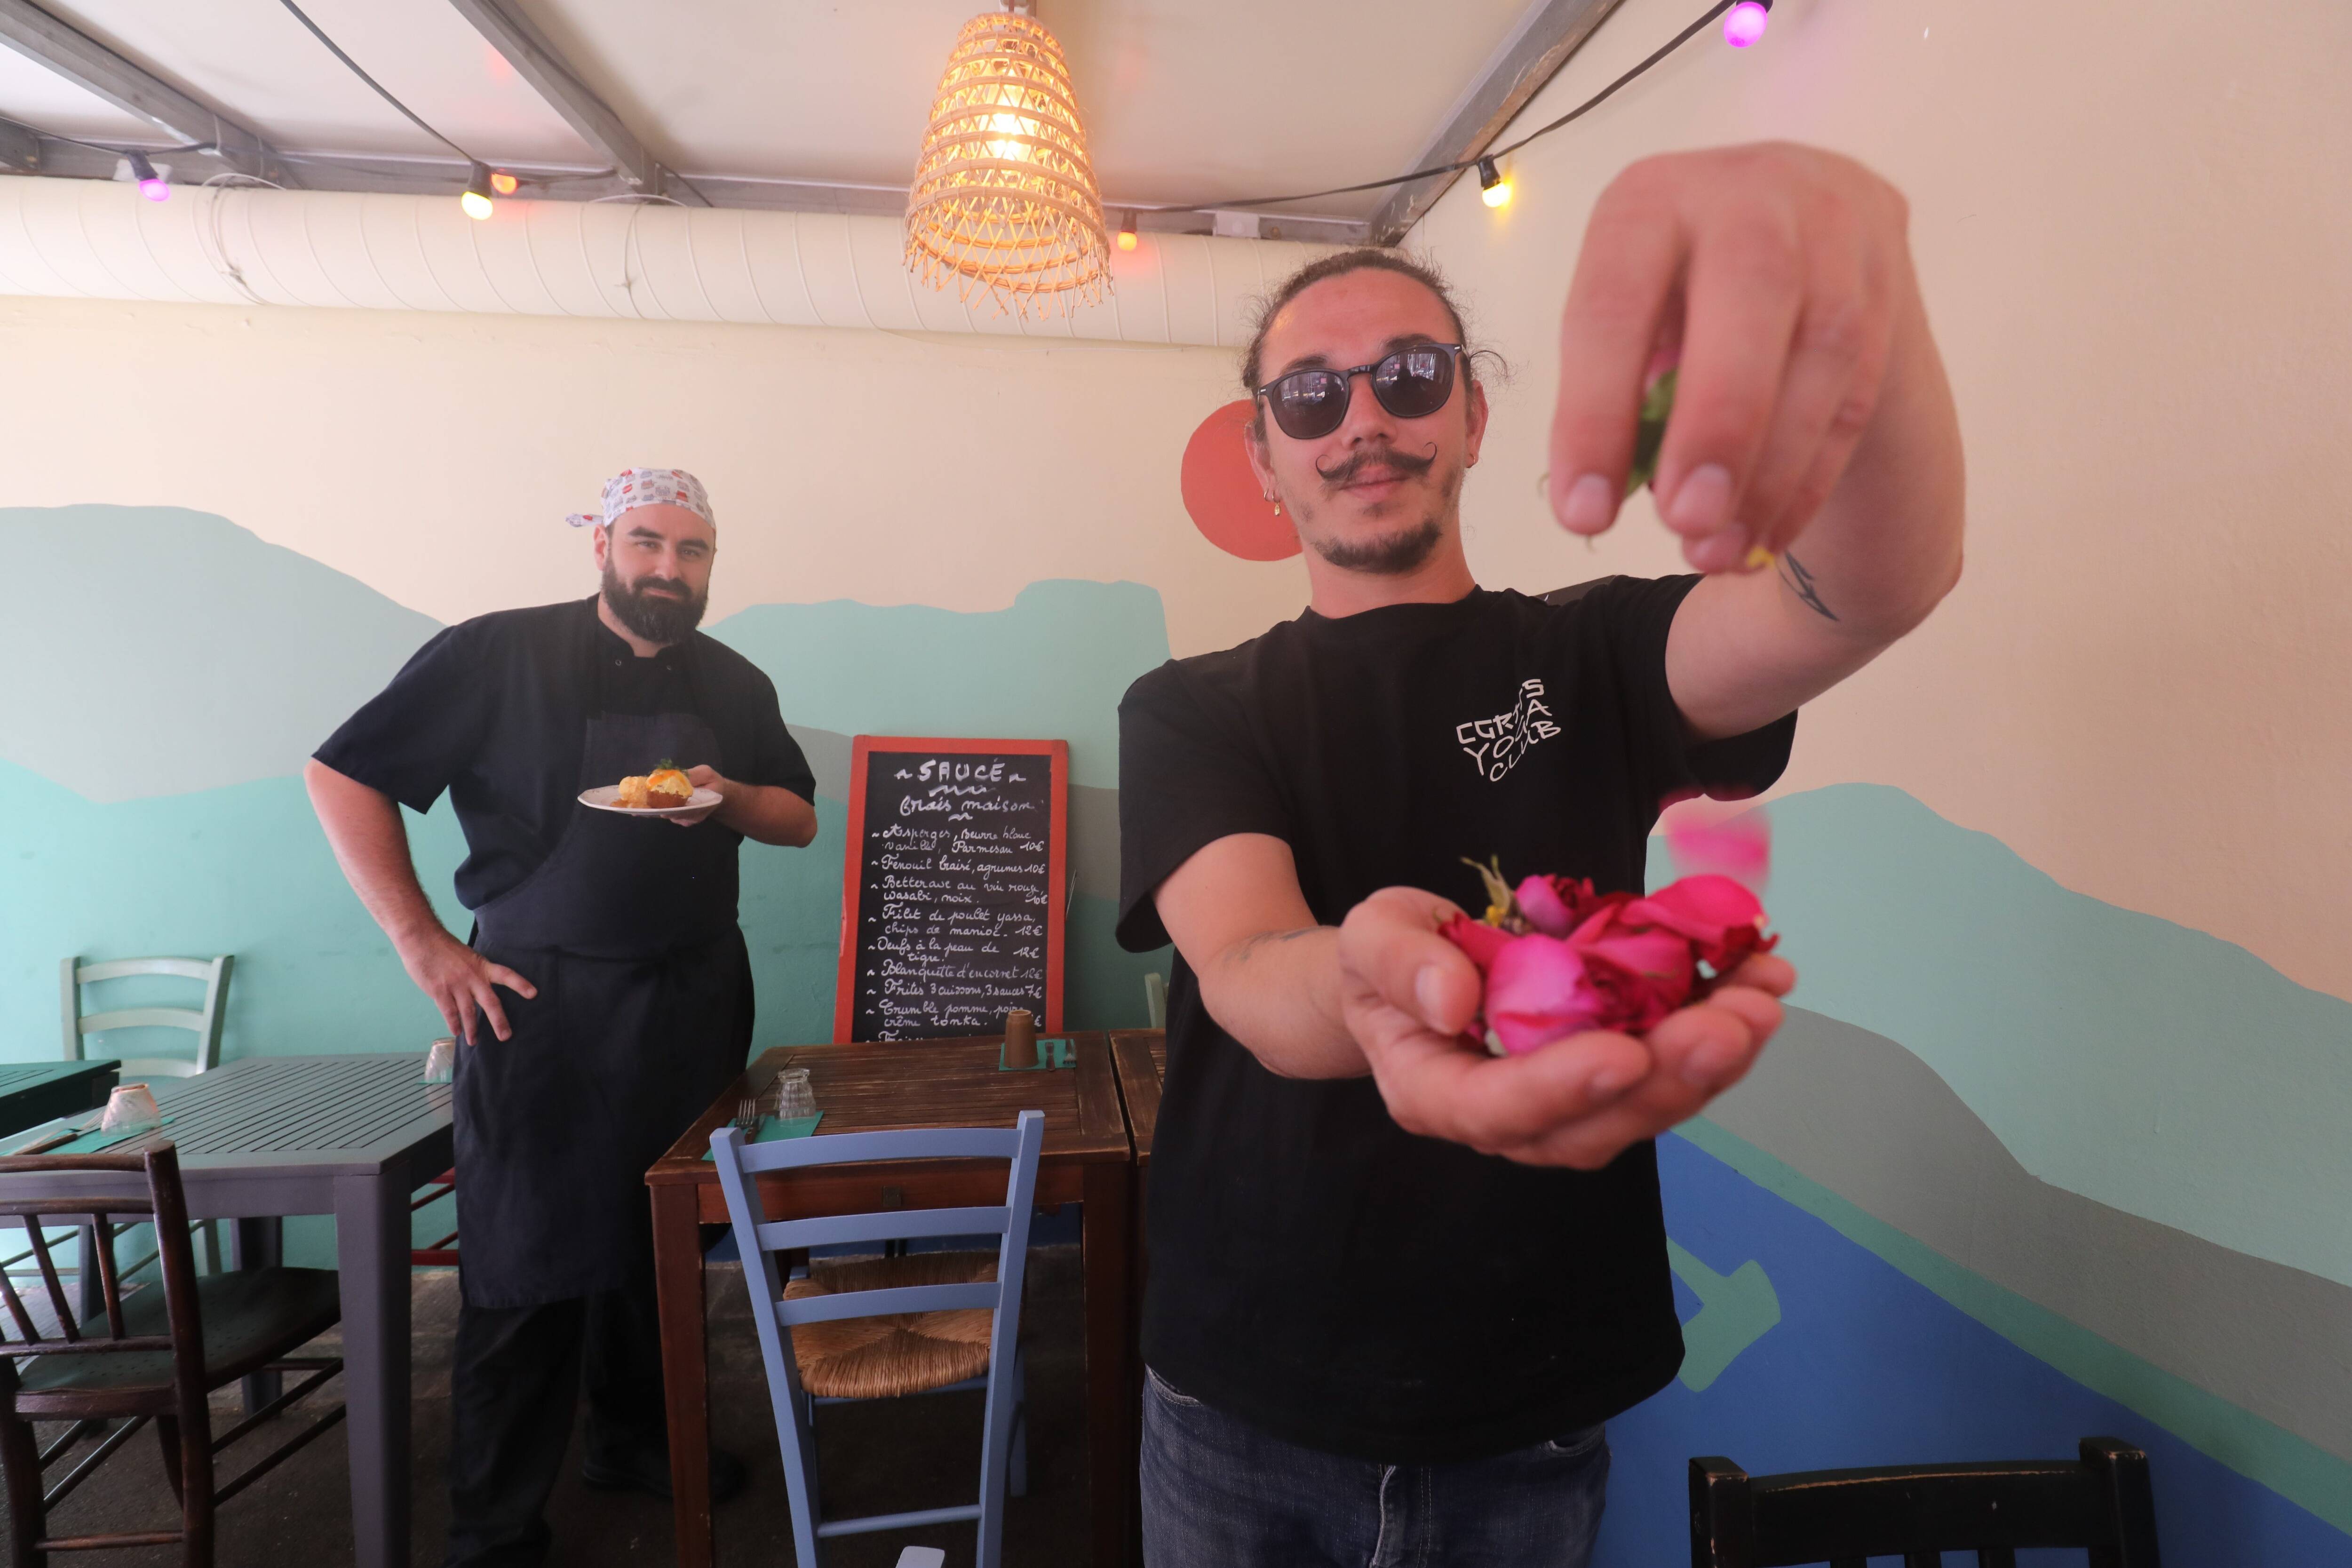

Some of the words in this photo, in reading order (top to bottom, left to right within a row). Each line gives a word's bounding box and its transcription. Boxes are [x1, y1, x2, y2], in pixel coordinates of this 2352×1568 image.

[961, 795, 1035, 812] maison
[881, 853, 932, 869] Fenouil
[977, 864, 1023, 880] agrumes
[882, 875, 951, 889] Betterave
[984, 881, 1004, 891] vin
[882, 901, 921, 919] Filet
[929, 909, 945, 921] de
[947, 907, 991, 925] poulet
[885, 922, 919, 937] chips
[926, 924, 940, 934] de
[877, 936, 911, 956] Oeufs
[929, 937, 941, 950] la
[944, 942, 974, 958] peau
[981, 941, 1000, 953] de
[881, 959, 956, 983] Blanquette
